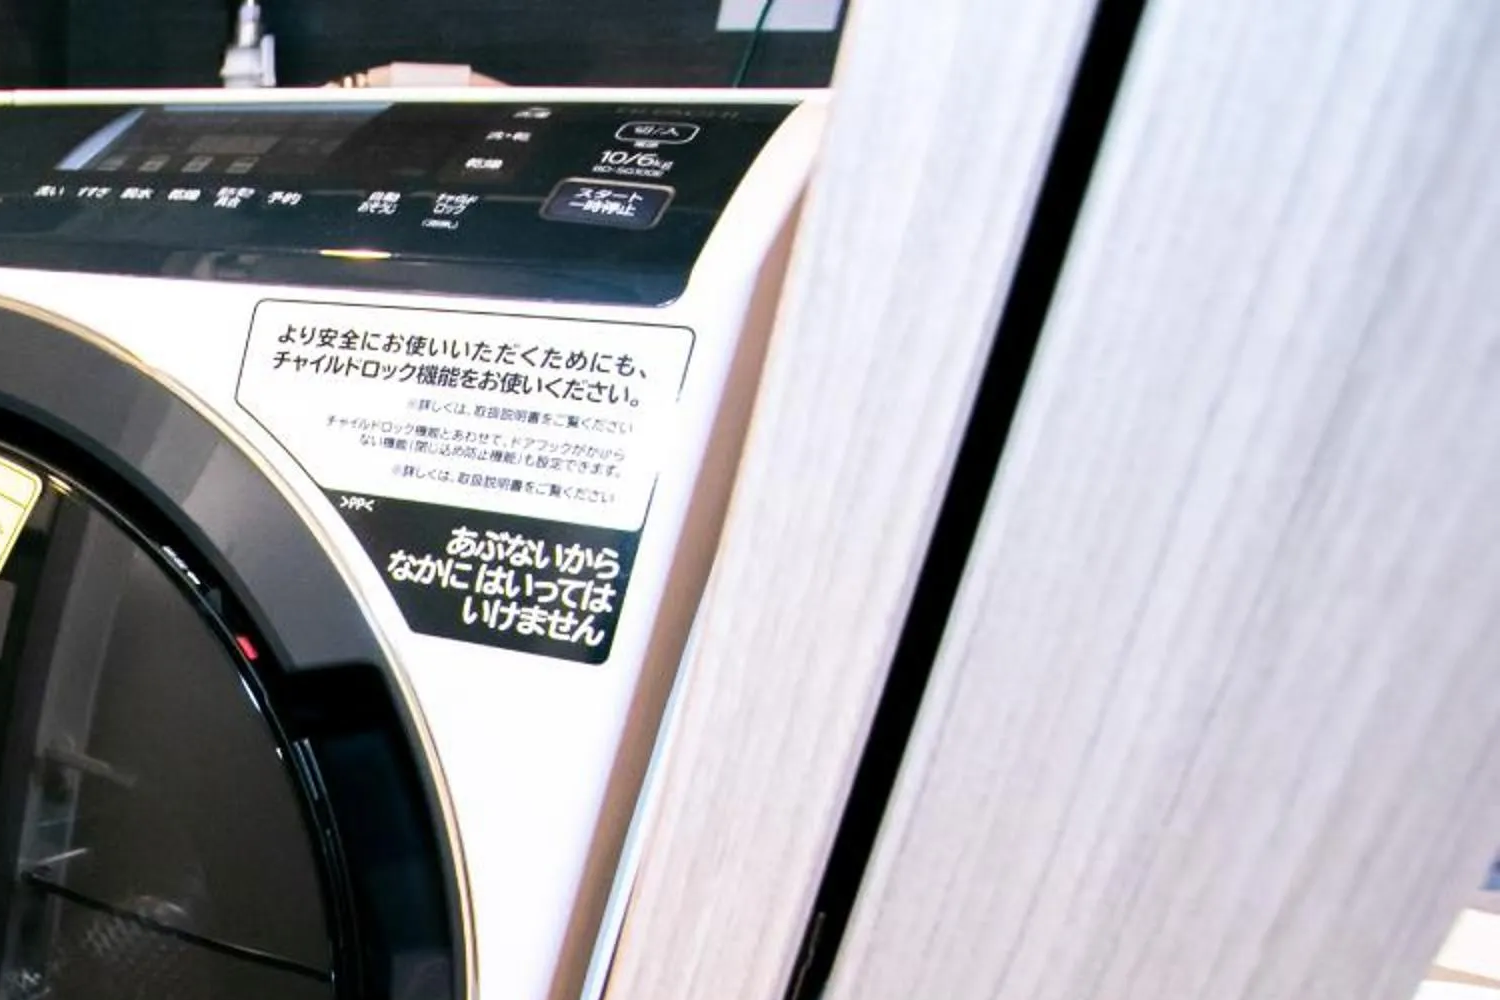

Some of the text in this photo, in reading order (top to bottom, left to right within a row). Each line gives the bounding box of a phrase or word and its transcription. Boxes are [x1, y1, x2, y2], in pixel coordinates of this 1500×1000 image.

[273, 350, 639, 407] チャイルドロック機能をお使いください。
[278, 324, 647, 379] より安全にお使いいただくためにも、
[446, 525, 620, 580] あぶないから
[462, 595, 605, 647] いけません
